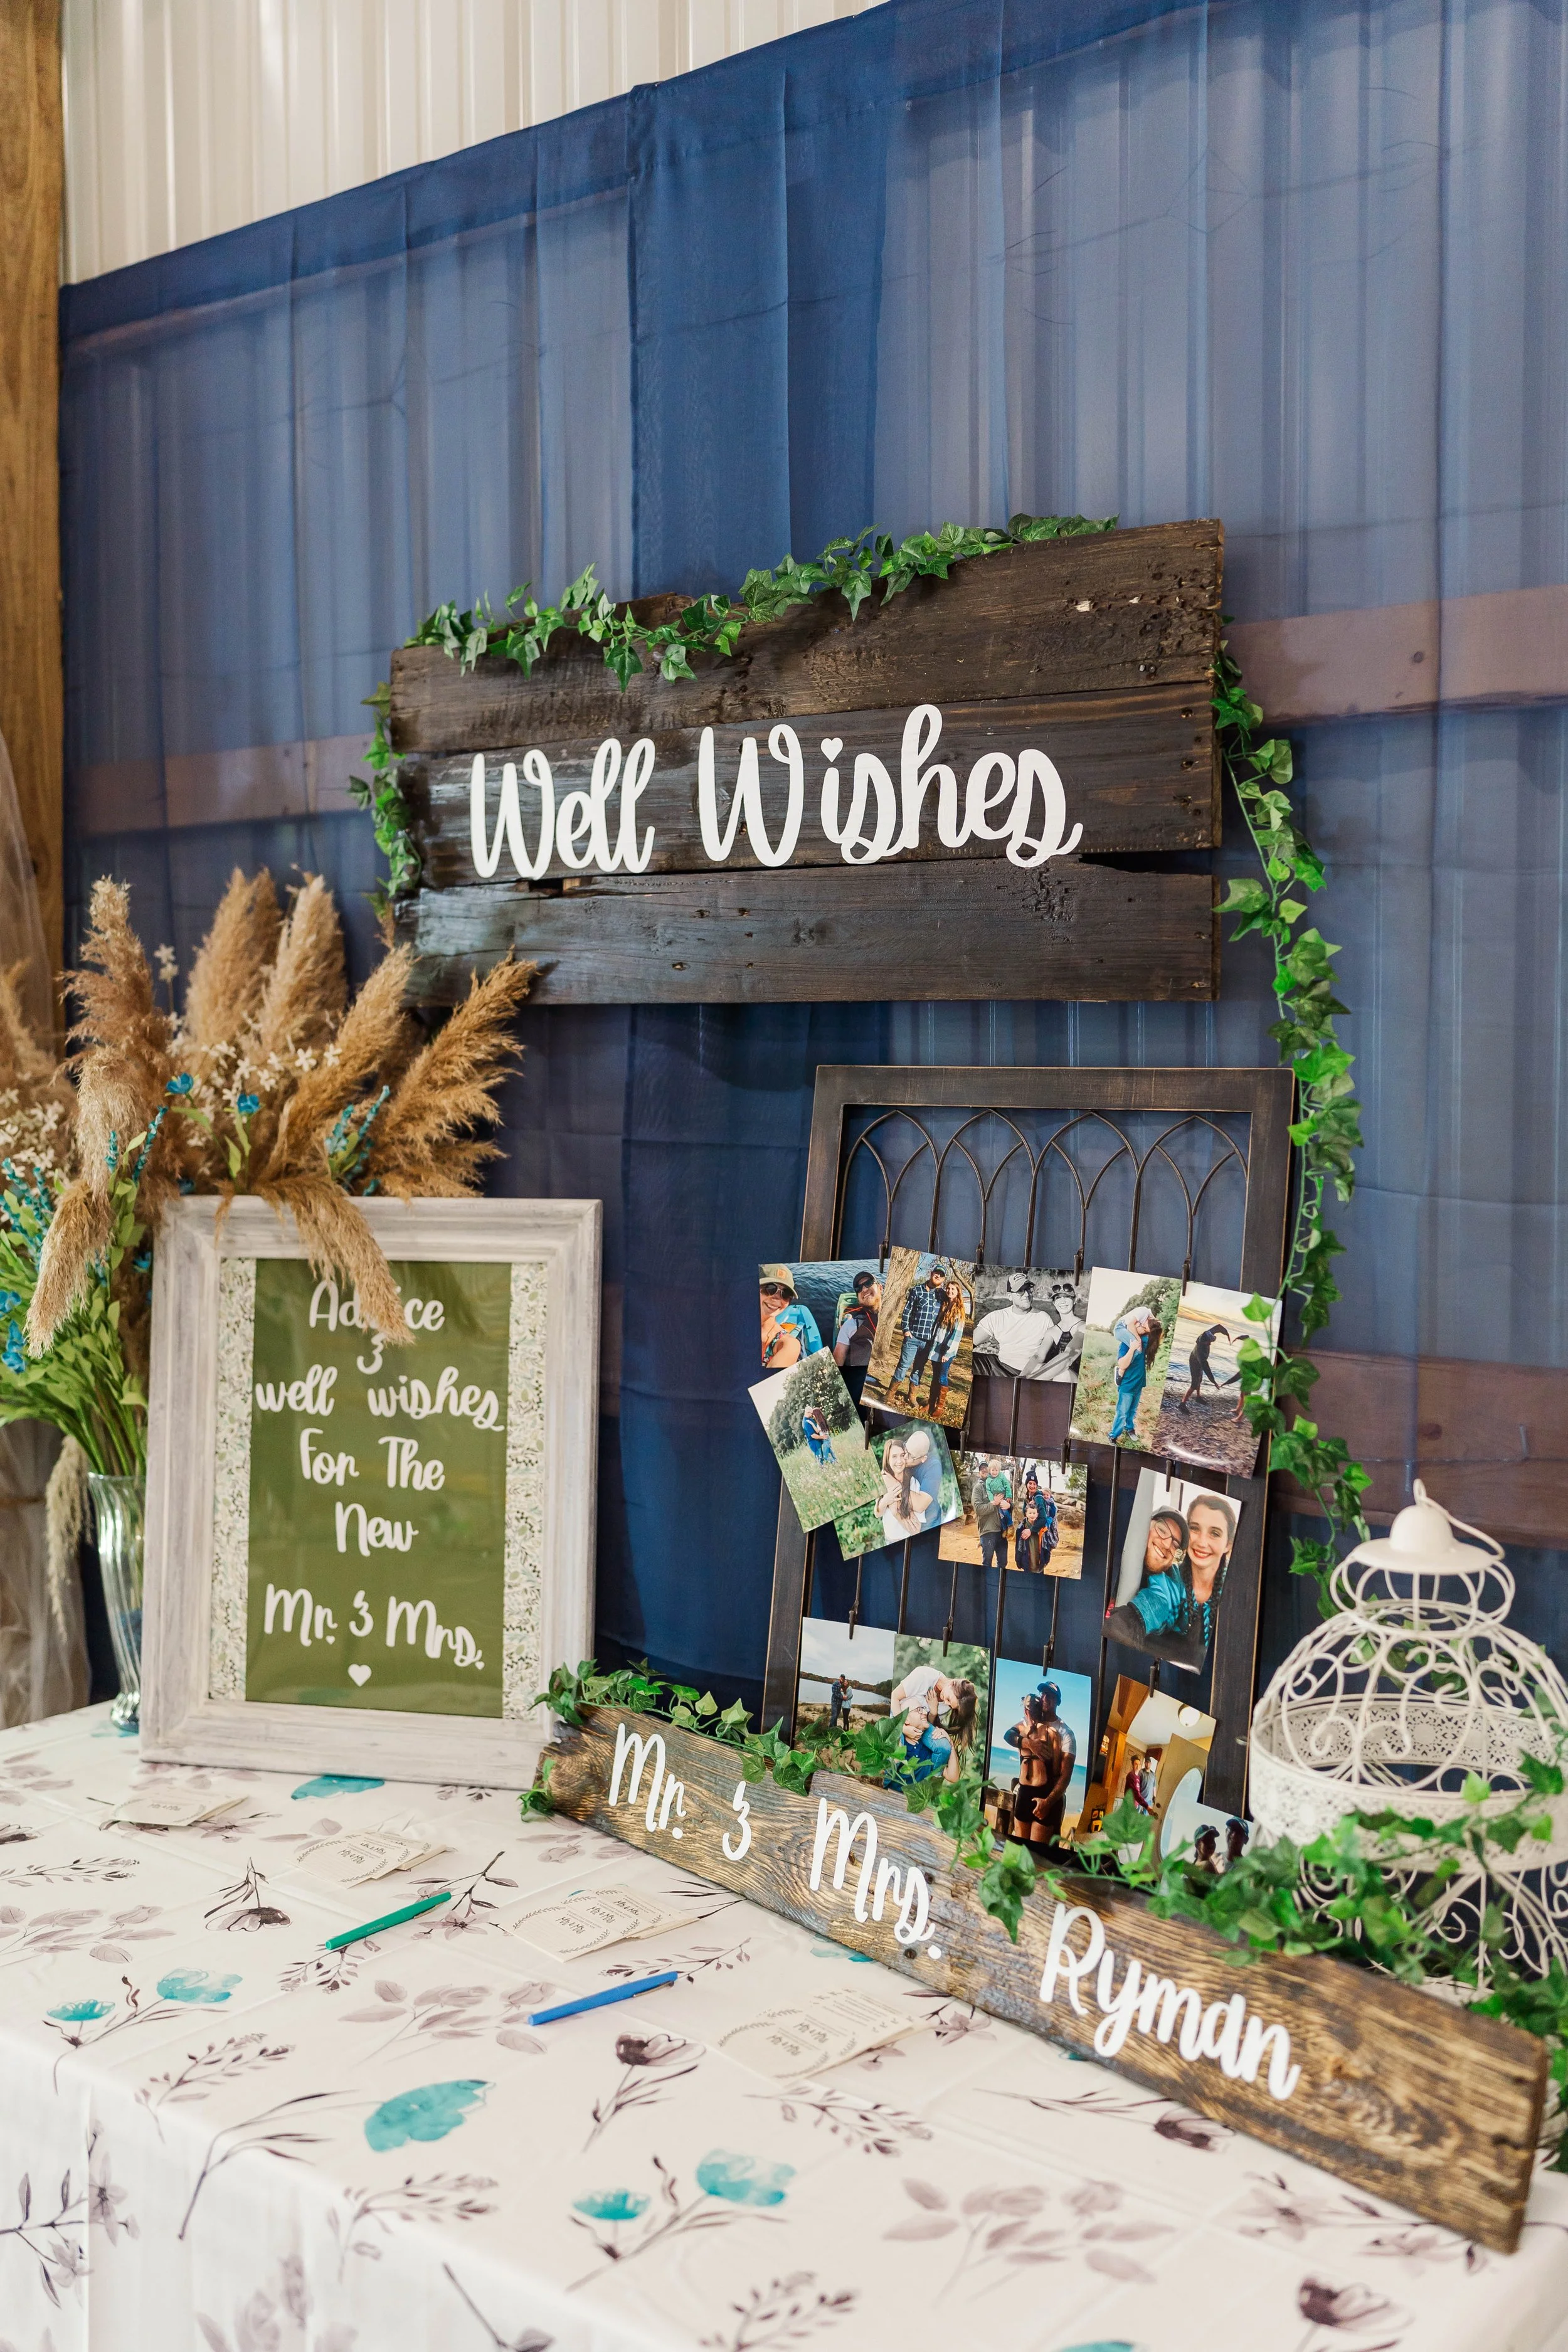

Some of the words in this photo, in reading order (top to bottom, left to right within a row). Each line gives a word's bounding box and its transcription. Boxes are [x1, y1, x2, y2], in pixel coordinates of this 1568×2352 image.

[470, 738, 655, 880] Well
[698, 704, 1083, 868] Wishes
[255, 1364, 337, 1416] well
[368, 1366, 505, 1431] wishes
[300, 1428, 359, 1486] For
[378, 1436, 445, 1491] The
[335, 1502, 419, 1557] New
[1039, 1902, 1301, 2100] Ryman
